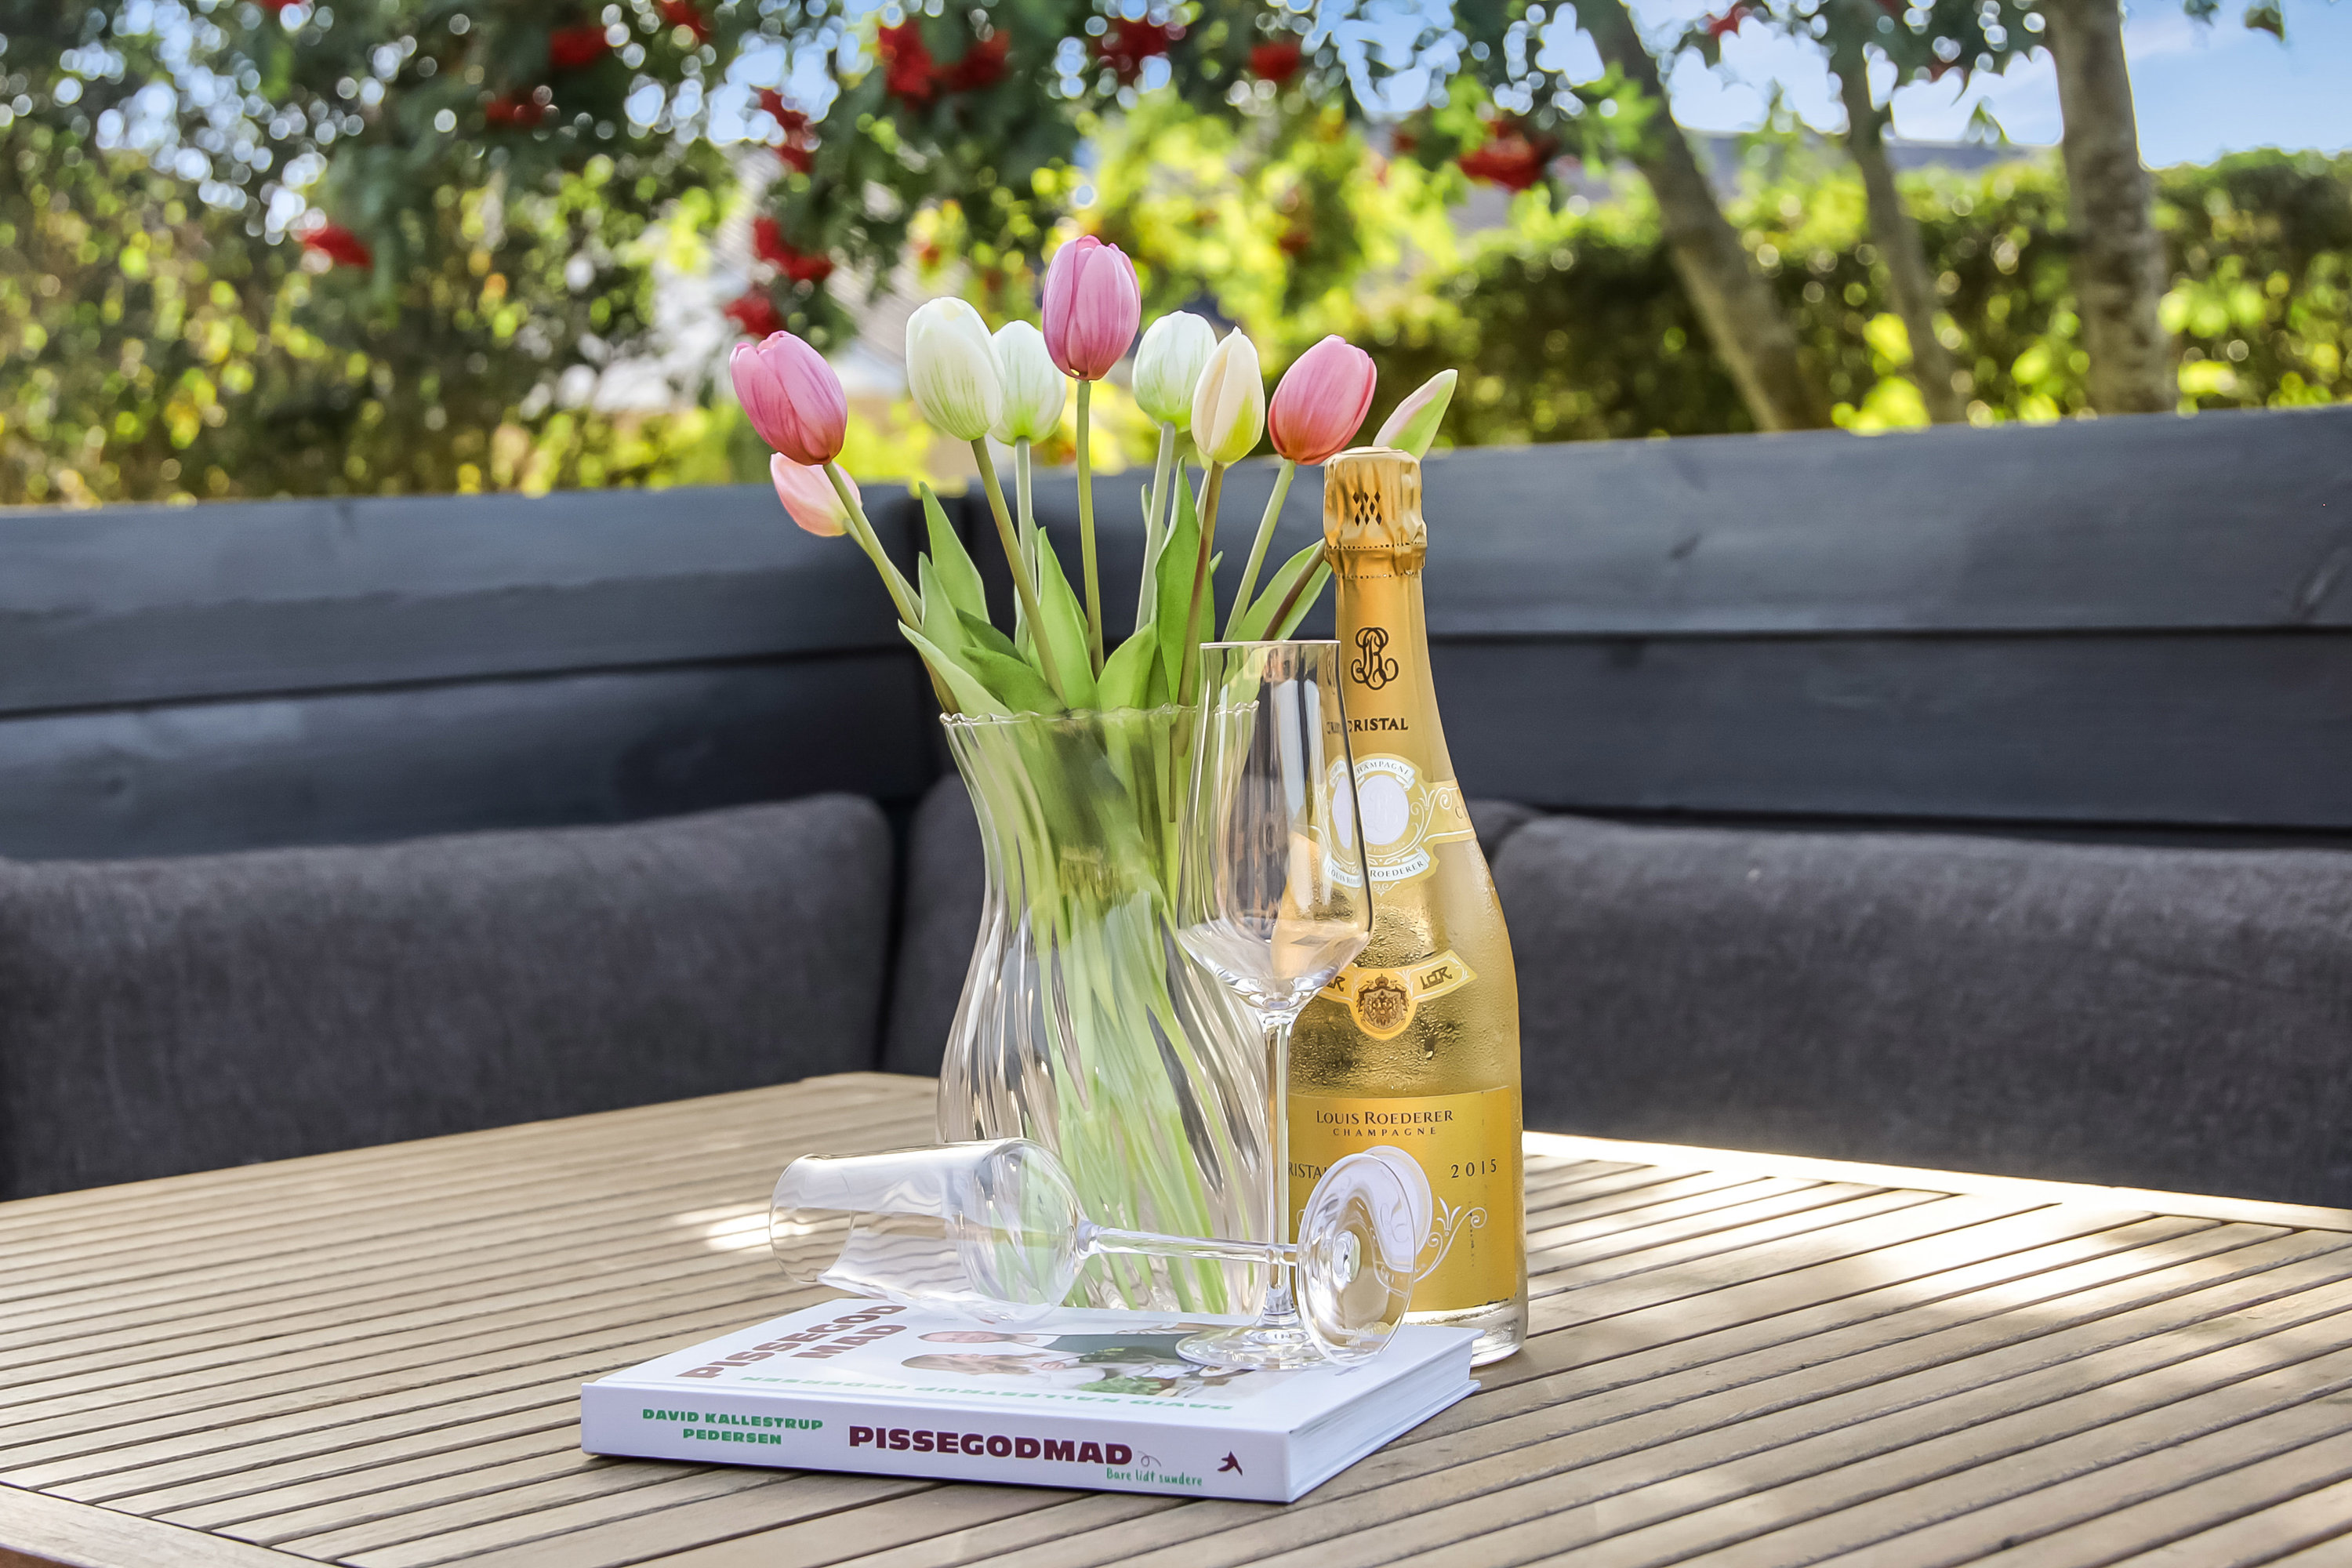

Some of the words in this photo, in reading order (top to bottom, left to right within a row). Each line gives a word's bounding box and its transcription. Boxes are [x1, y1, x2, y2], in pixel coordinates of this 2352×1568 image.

[1356, 760, 1410, 776] HAMPAGNE
[1370, 860, 1424, 877] ROEDERER
[1316, 1110, 1359, 1124] LOUIS
[1365, 1110, 1454, 1124] ROEDERER
[1333, 1127, 1436, 1137] CHAMPAGNE
[1288, 1161, 1327, 1179] RISTA
[1450, 1158, 1497, 1178] 2015
[675, 1305, 907, 1378] PISSEGOD
[789, 1325, 907, 1359] MAD
[642, 1409, 699, 1422] DAVID
[705, 1413, 823, 1430] KALLESTRUP
[683, 1428, 782, 1445] PEDERSEN
[849, 1425, 1133, 1465] PISSEGODMAD
[1106, 1467, 1131, 1481] Bare
[1135, 1468, 1156, 1483] lidt
[1159, 1472, 1203, 1486] sundere
